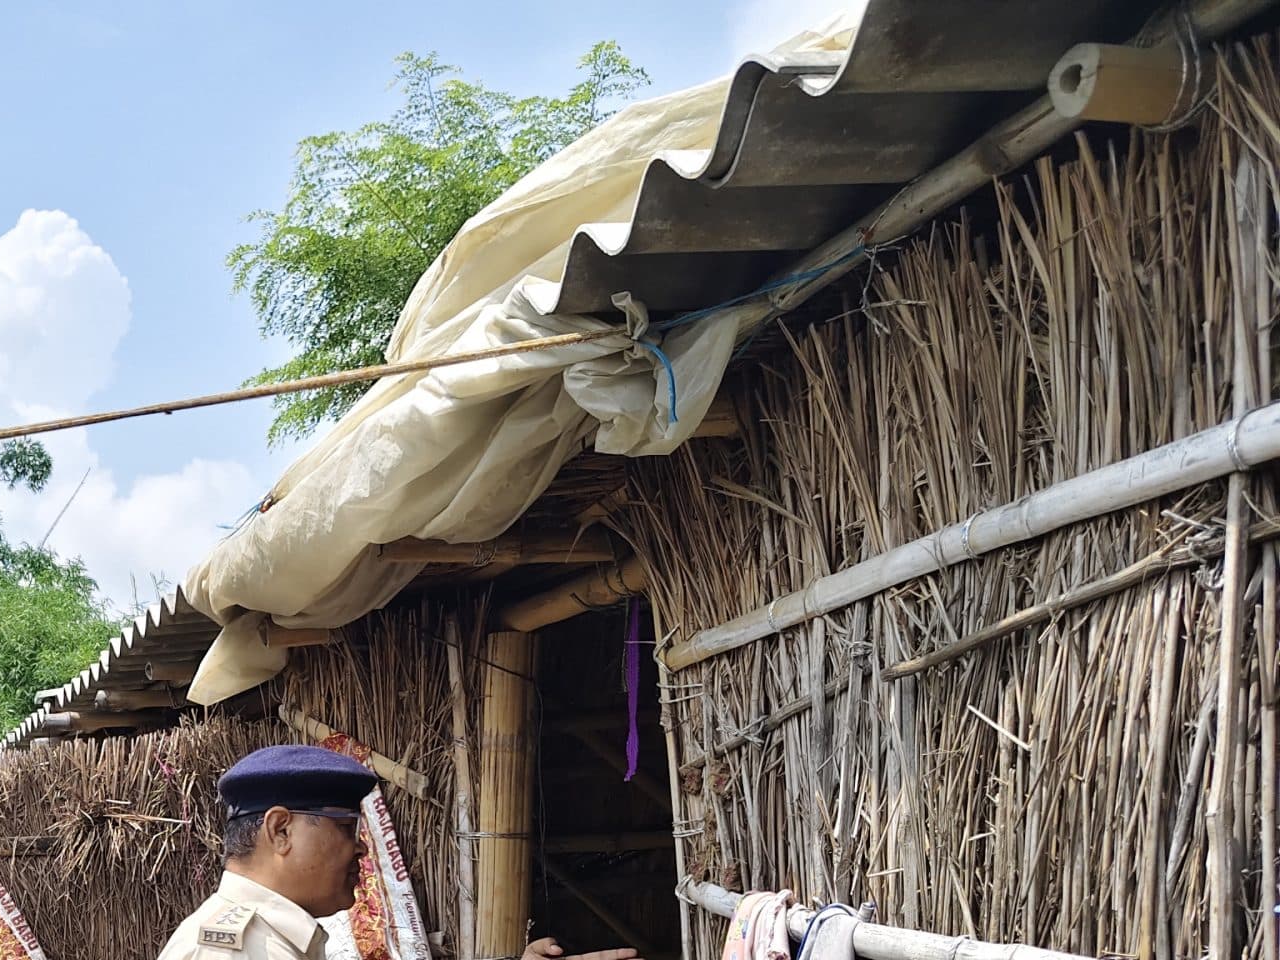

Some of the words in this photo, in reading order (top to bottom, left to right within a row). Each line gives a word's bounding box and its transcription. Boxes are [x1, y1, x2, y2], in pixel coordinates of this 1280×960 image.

[373, 796, 394, 838] RAJA
[385, 839, 410, 882] BABU
[11, 914, 39, 951] BABU
[402, 890, 422, 942] Premium
